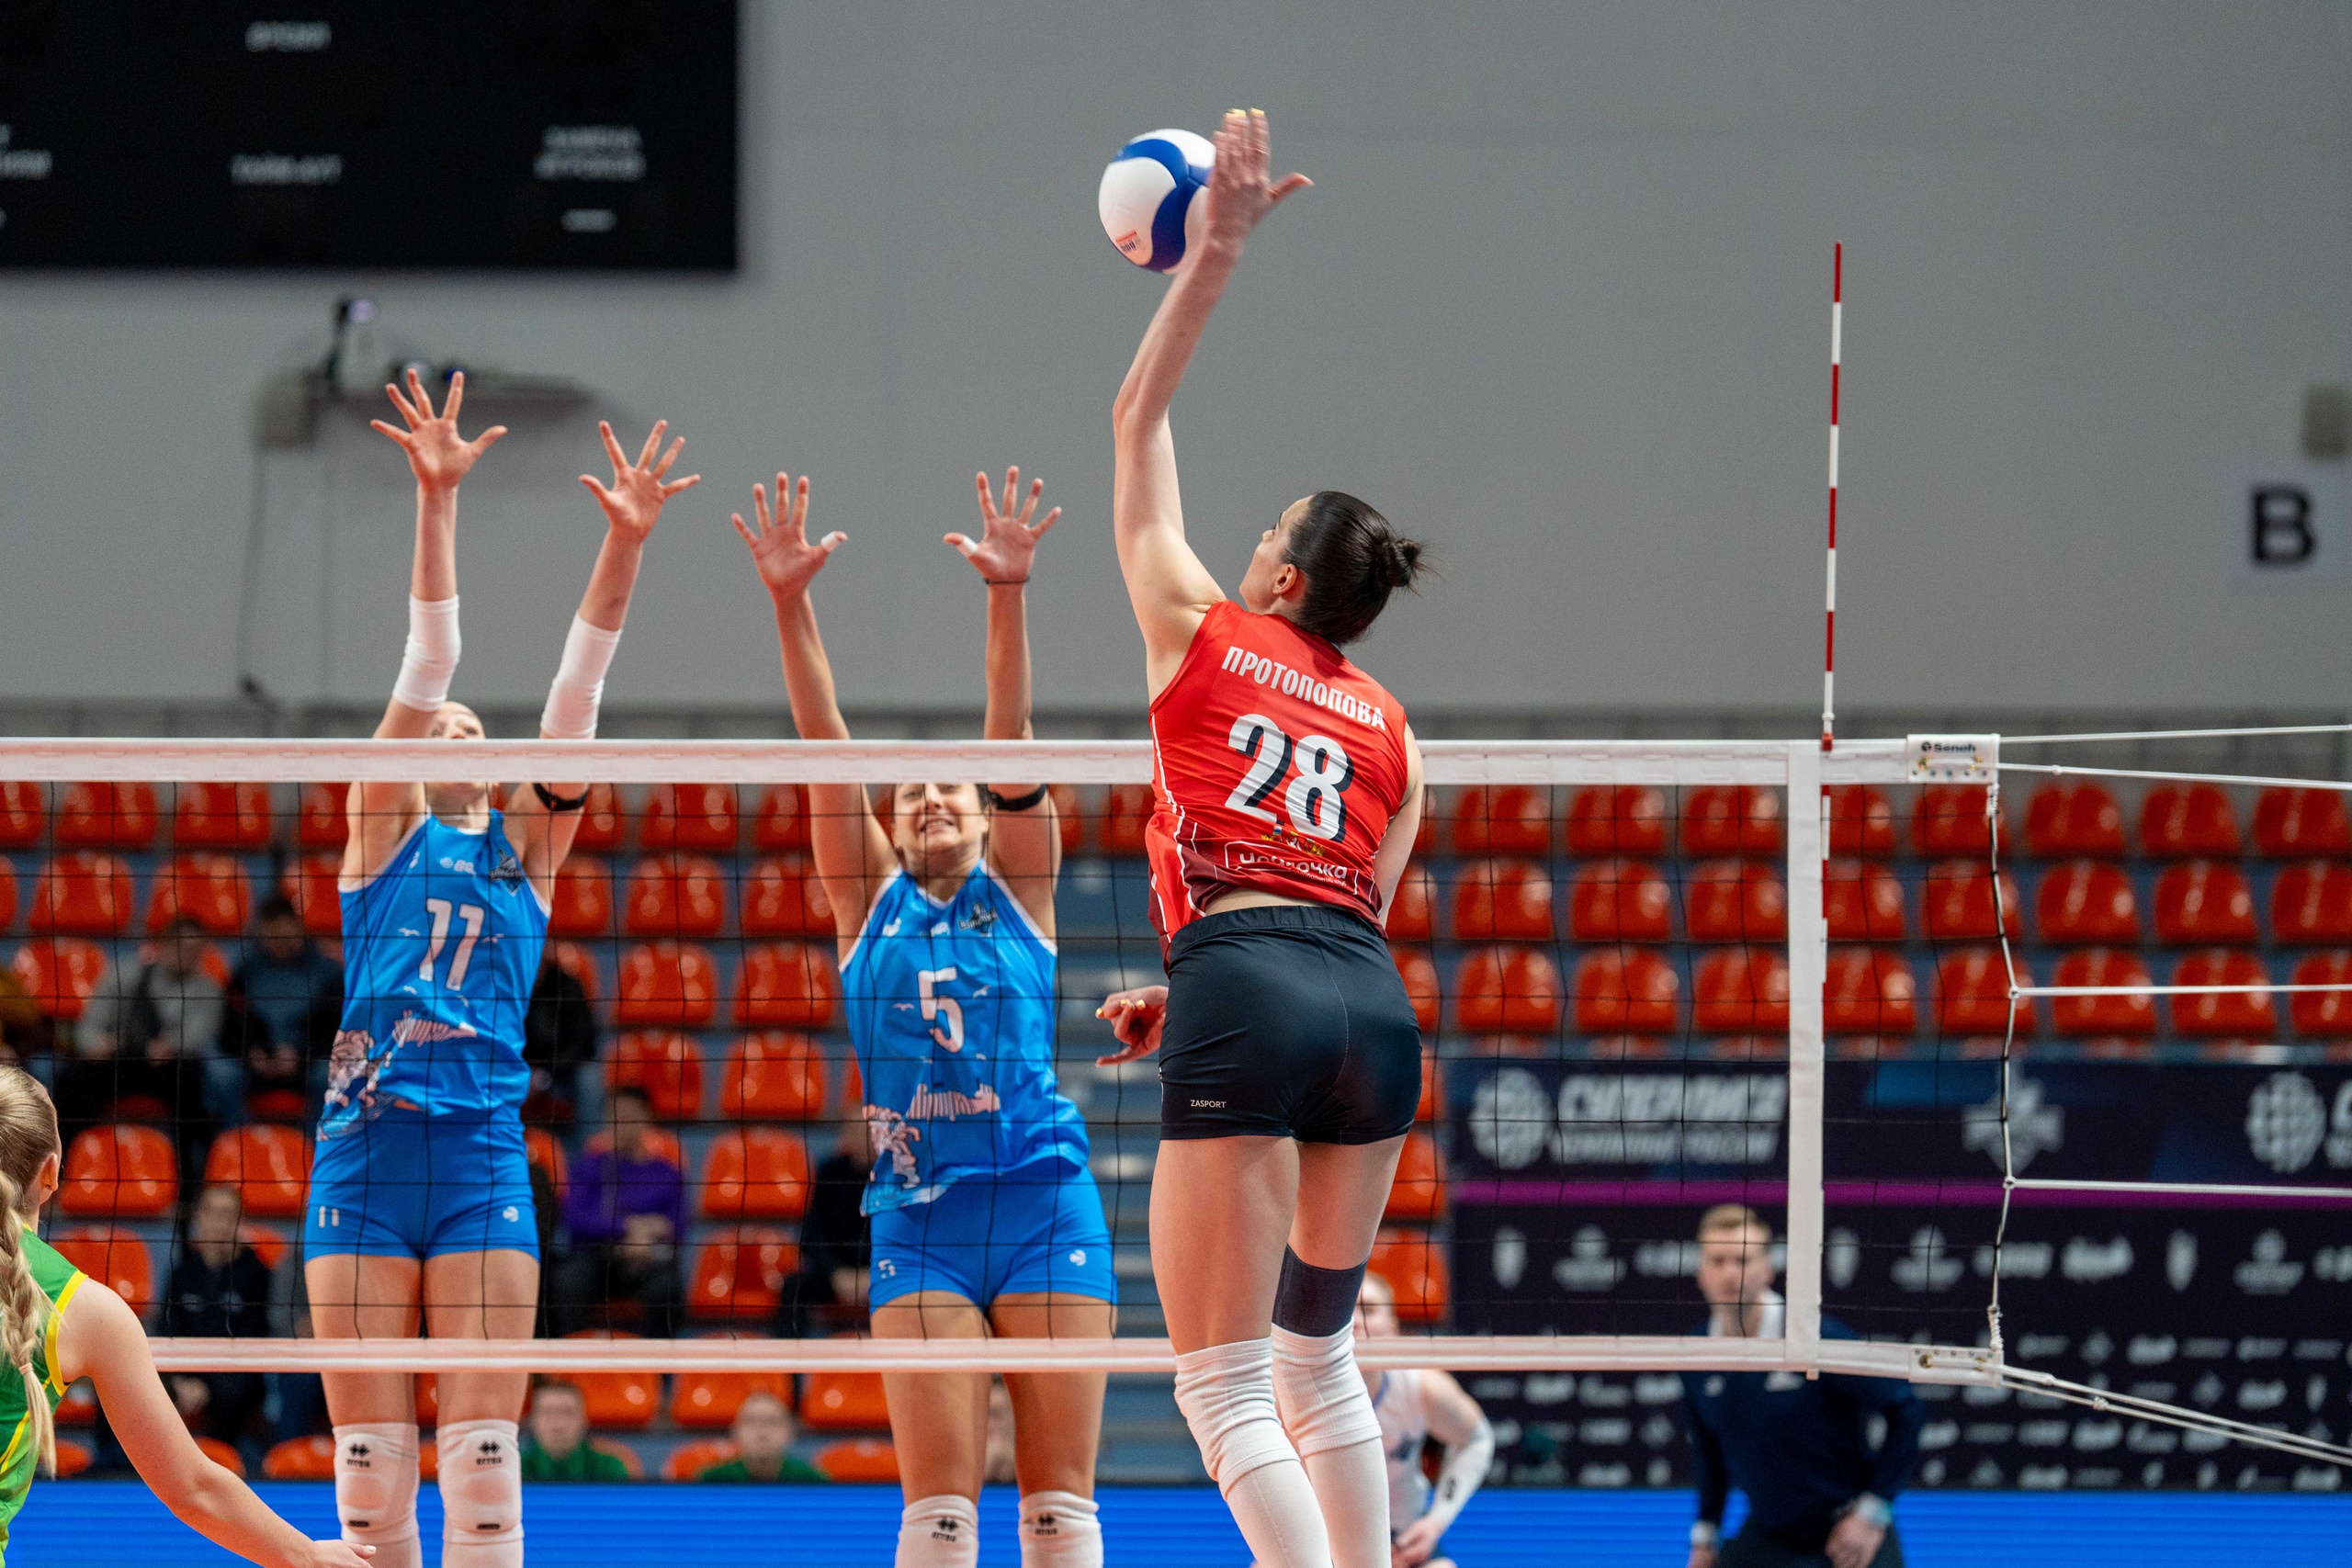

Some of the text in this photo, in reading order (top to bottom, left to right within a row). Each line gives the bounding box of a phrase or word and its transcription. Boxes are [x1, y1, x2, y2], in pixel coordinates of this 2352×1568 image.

[1221, 646, 1385, 730] ПРОТОПОПОВА
[1225, 713, 1354, 843] 28
[918, 967, 965, 1054] 5
[1190, 1100, 1227, 1108] ZASPORT
